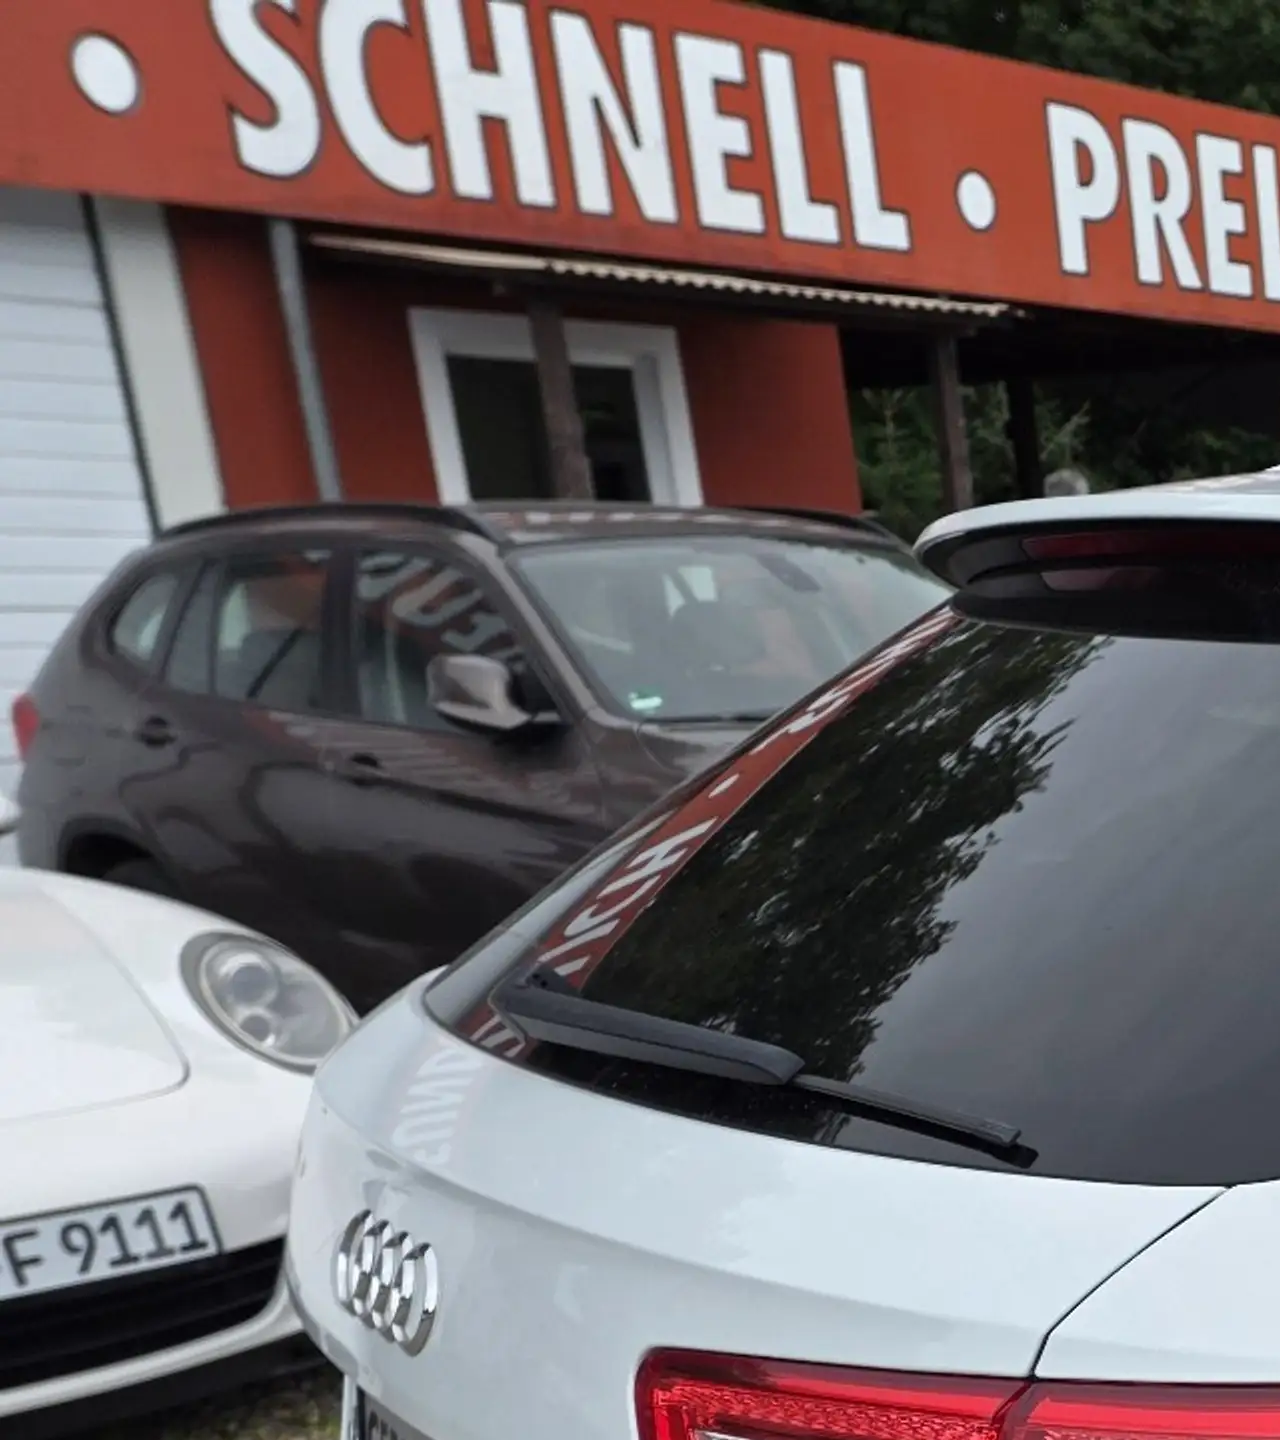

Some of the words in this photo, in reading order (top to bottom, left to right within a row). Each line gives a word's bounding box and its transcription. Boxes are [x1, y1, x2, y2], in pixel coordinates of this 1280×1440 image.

[208, 0, 912, 252] SCHNELL
[2, 1229, 43, 1288] F
[60, 1201, 209, 1275] 9111
